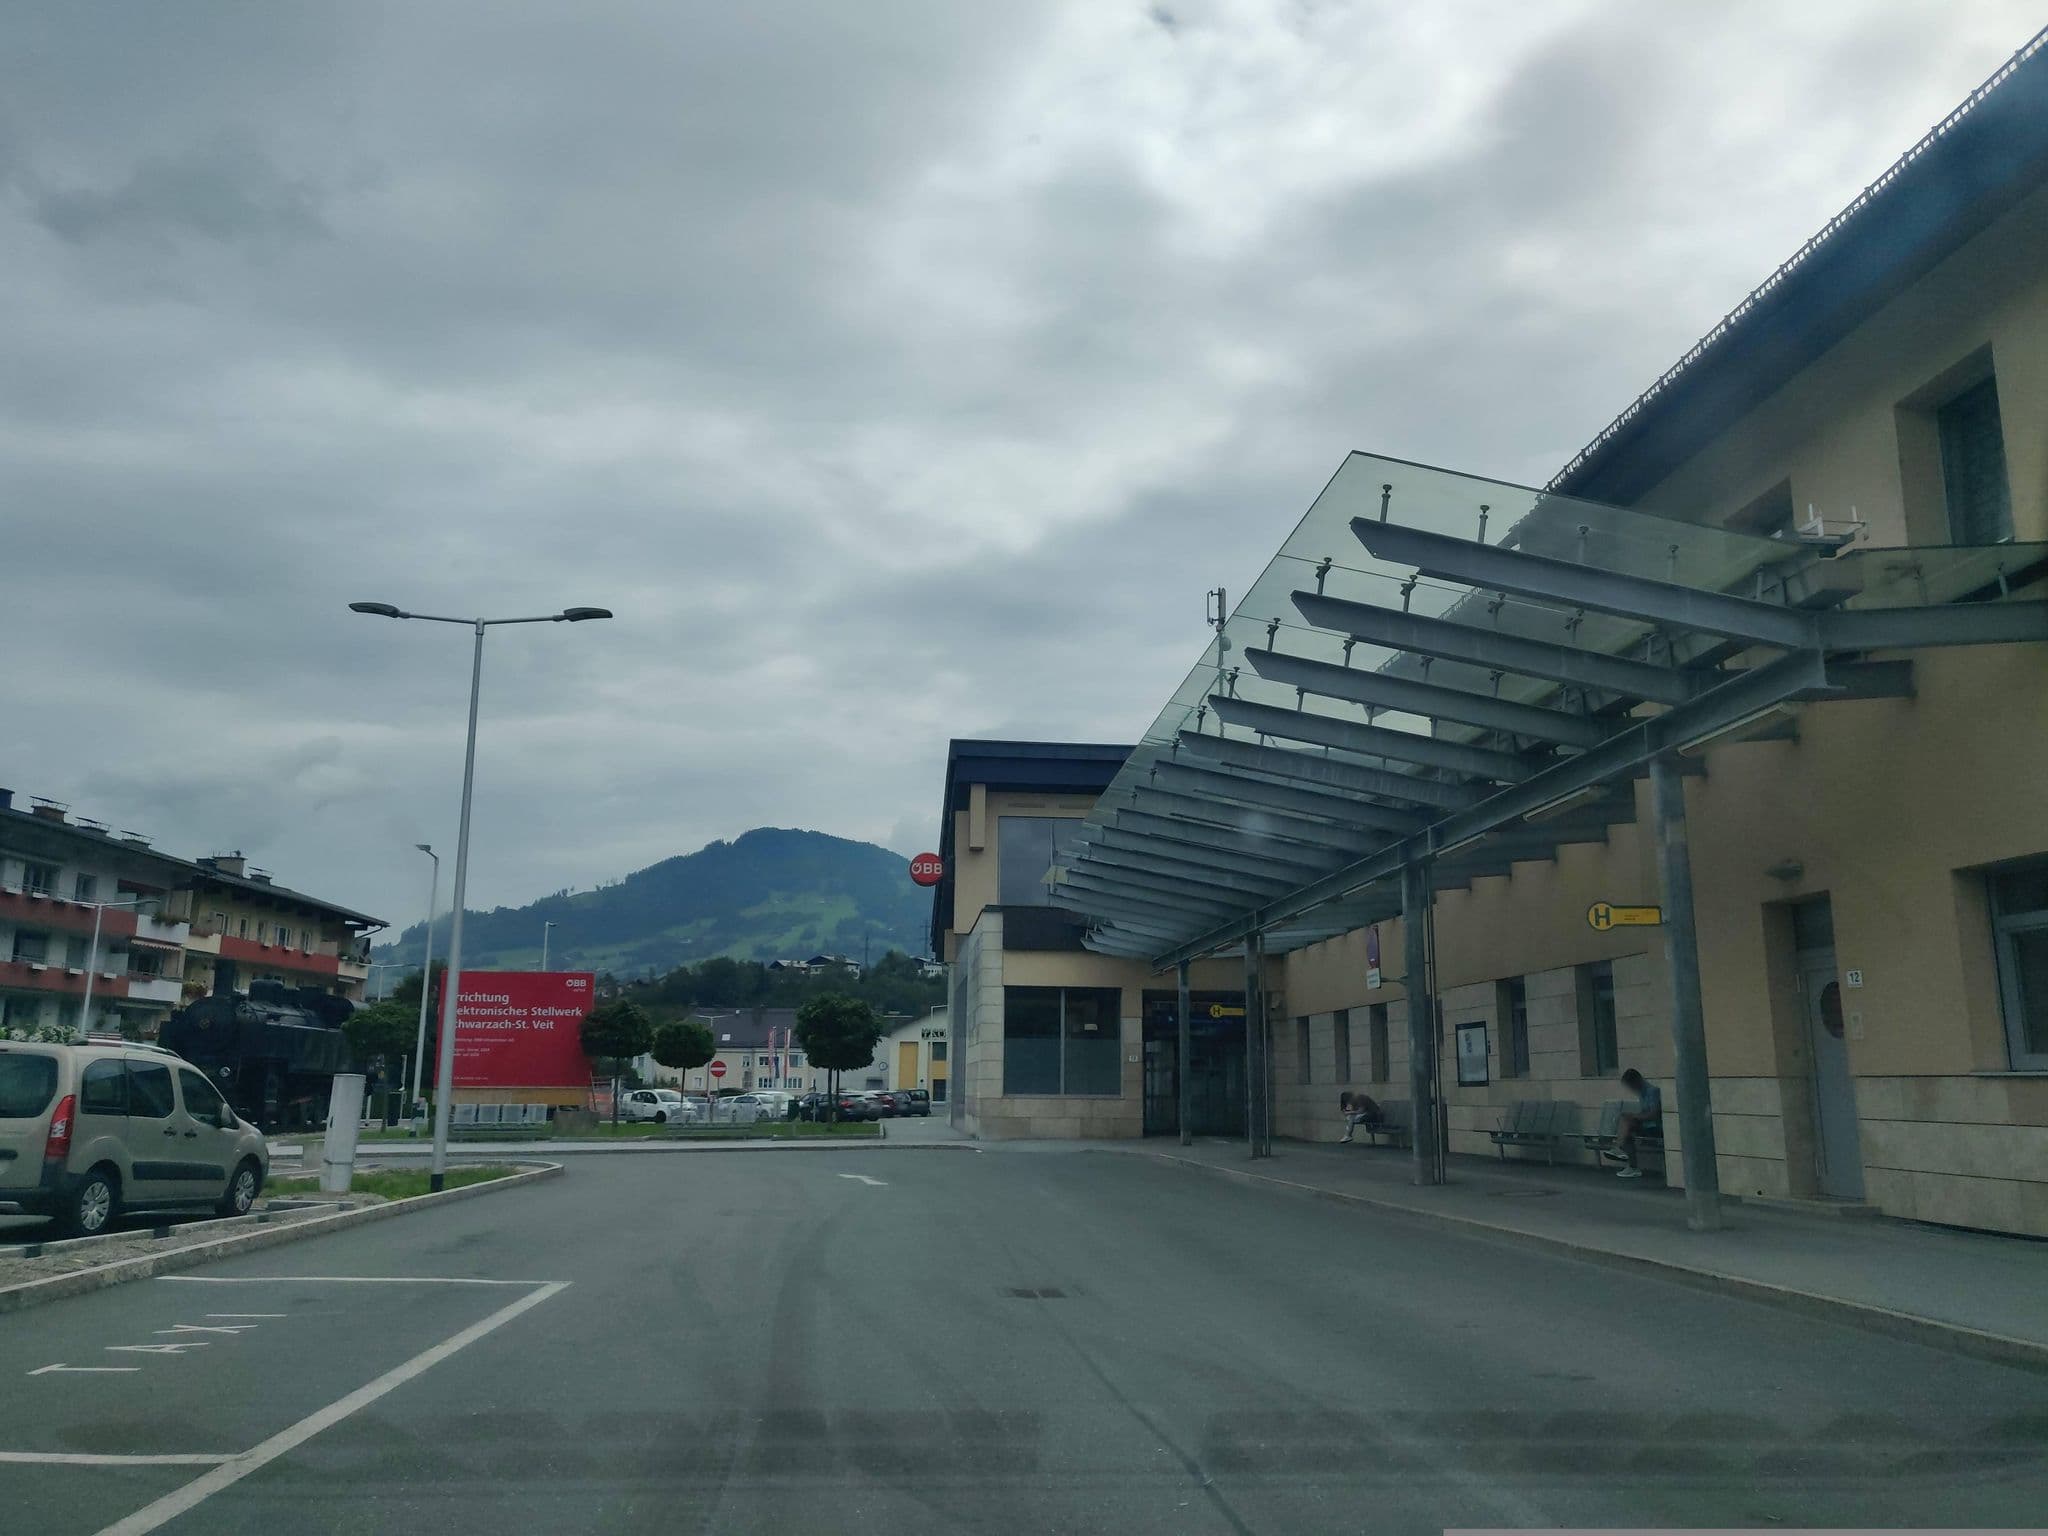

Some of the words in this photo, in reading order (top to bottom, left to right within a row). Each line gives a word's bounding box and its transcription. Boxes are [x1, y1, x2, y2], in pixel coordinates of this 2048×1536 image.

[911, 862, 943, 875] ÖBB
[1594, 907, 1611, 926] H
[1849, 971, 1860, 983] 12
[457, 992, 510, 1005] richtung
[456, 1006, 528, 1016] ektronisches
[531, 1006, 582, 1016] Stellwerk
[1213, 1007, 1221, 1015] H
[456, 1019, 530, 1029] hwarzach-St.
[532, 1020, 554, 1029] Veit
[26, 1312, 288, 1376] TAXI
